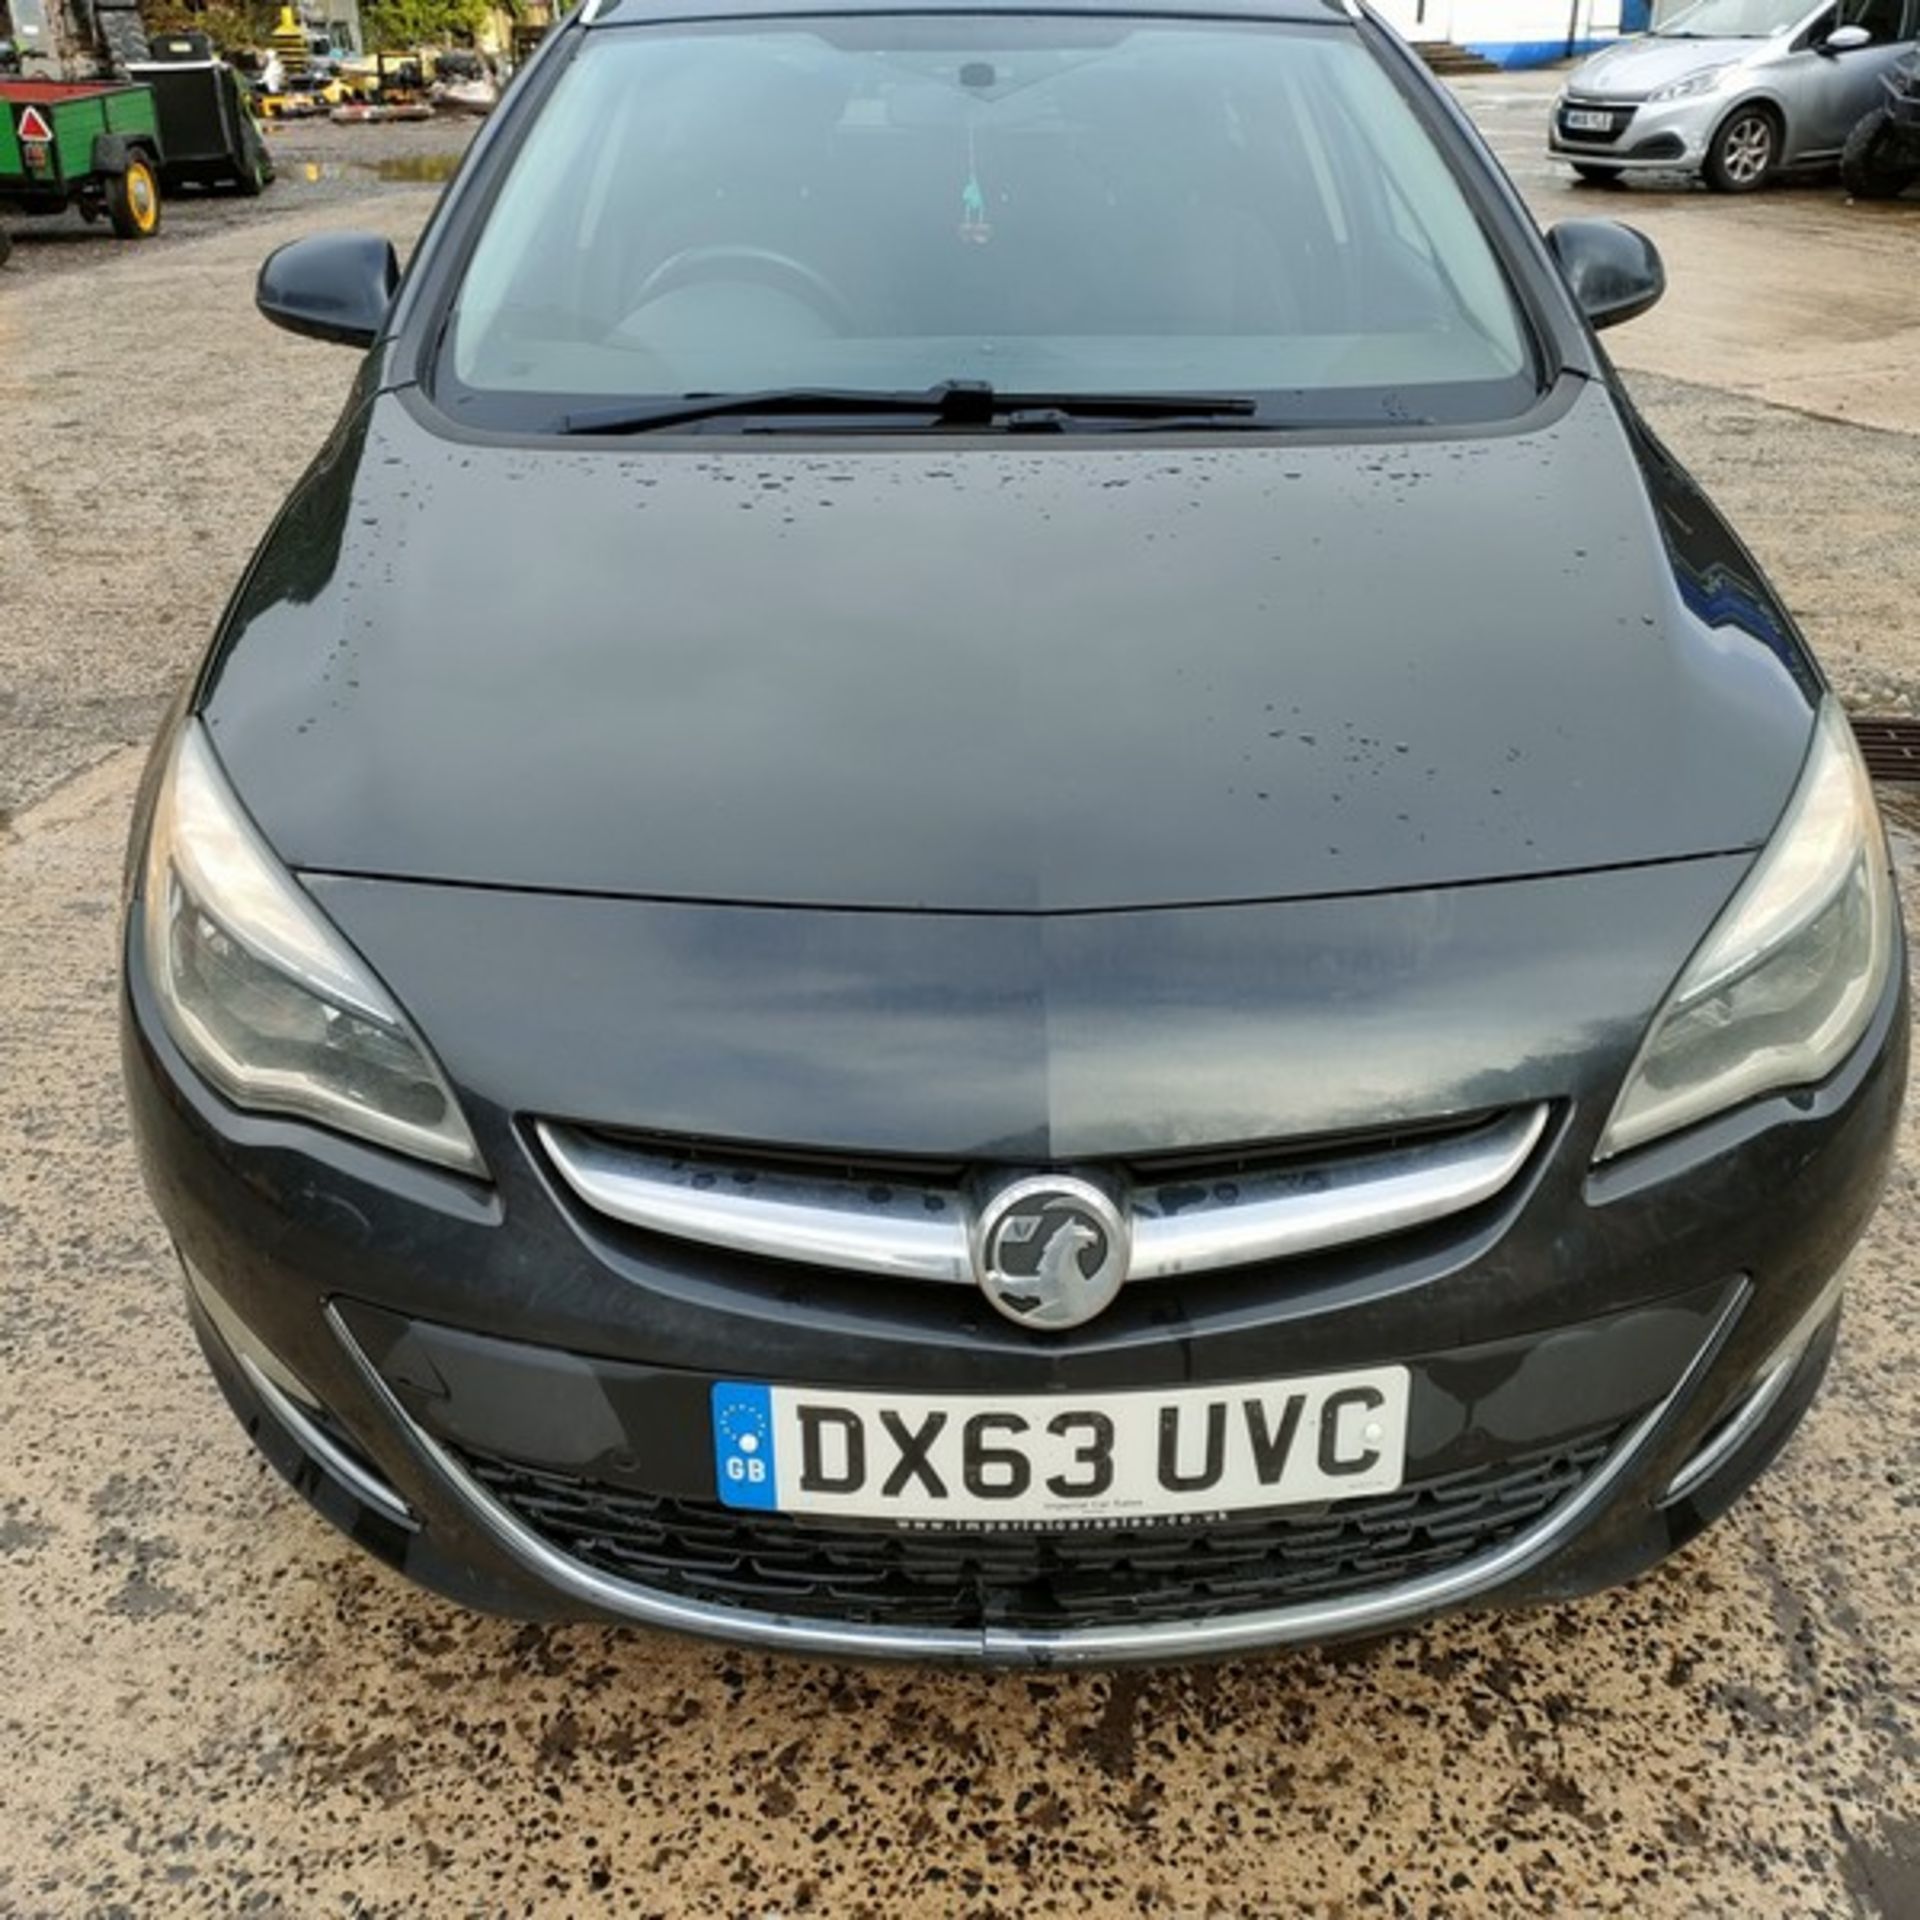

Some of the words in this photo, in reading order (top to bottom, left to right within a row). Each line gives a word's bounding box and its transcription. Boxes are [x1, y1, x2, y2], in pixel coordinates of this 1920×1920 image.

[726, 1456, 766, 1482] GB
[797, 1405, 1114, 1499] DX63
[1158, 1386, 1385, 1492] UVC
